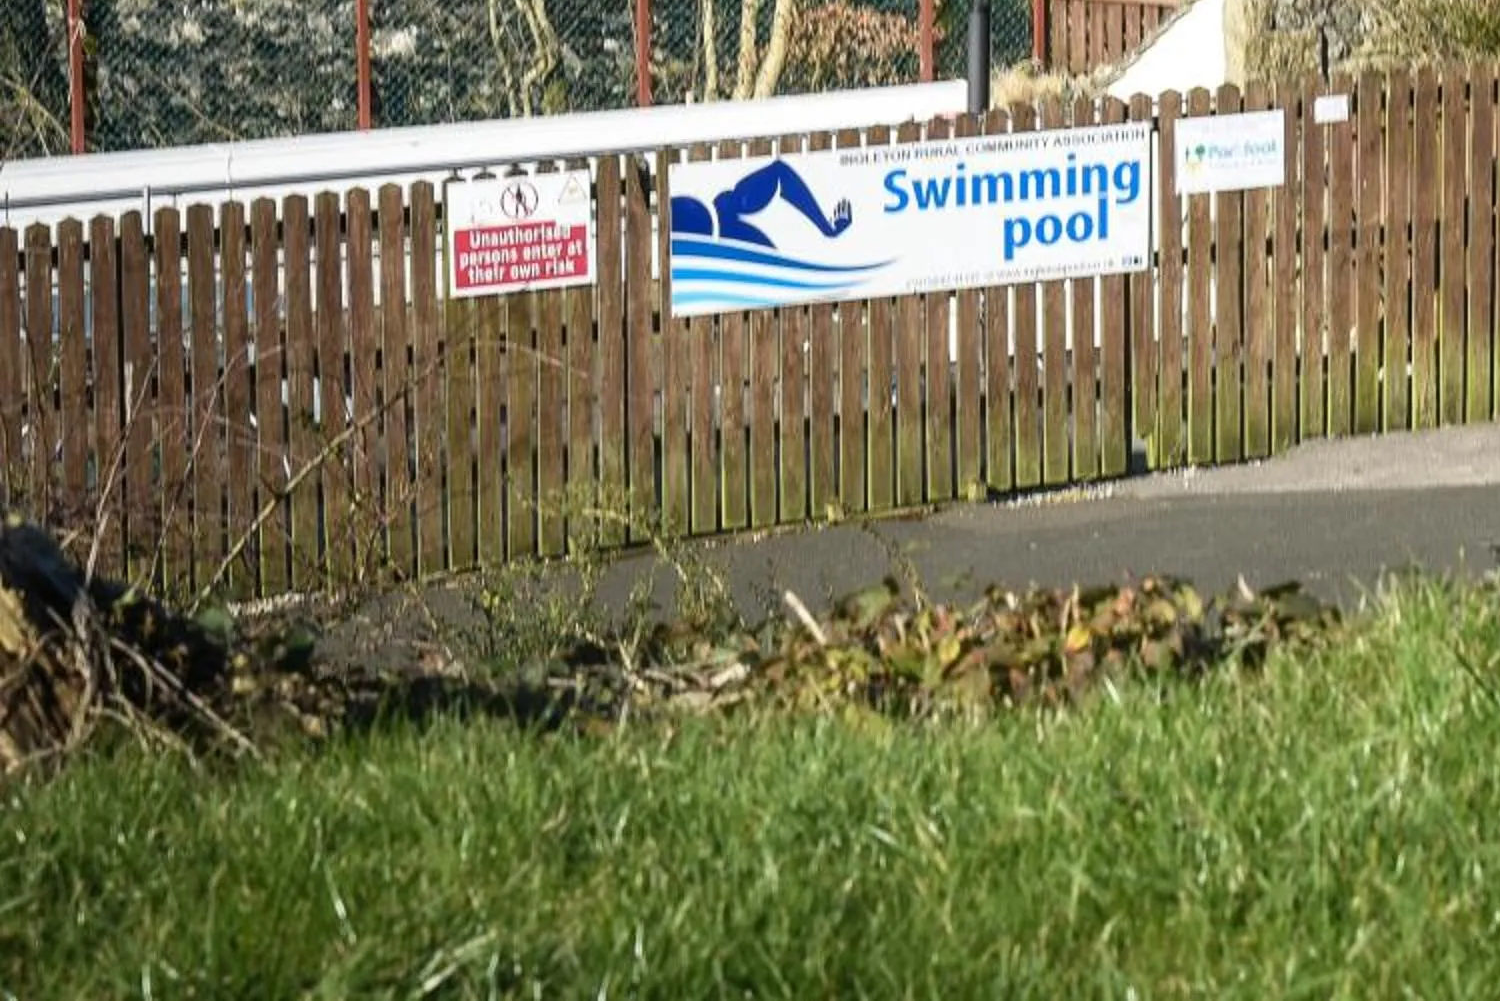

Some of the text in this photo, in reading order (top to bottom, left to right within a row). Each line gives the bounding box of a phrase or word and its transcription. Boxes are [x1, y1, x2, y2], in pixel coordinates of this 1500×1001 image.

[965, 137, 1049, 155] COMMUNITY
[1053, 127, 1145, 148] ASSOCIATION
[882, 152, 1141, 214] Swimming
[469, 223, 571, 249] Unauthorised
[1003, 197, 1108, 261] pool
[459, 239, 583, 269] persons enter at
[468, 257, 575, 284] their own risk
